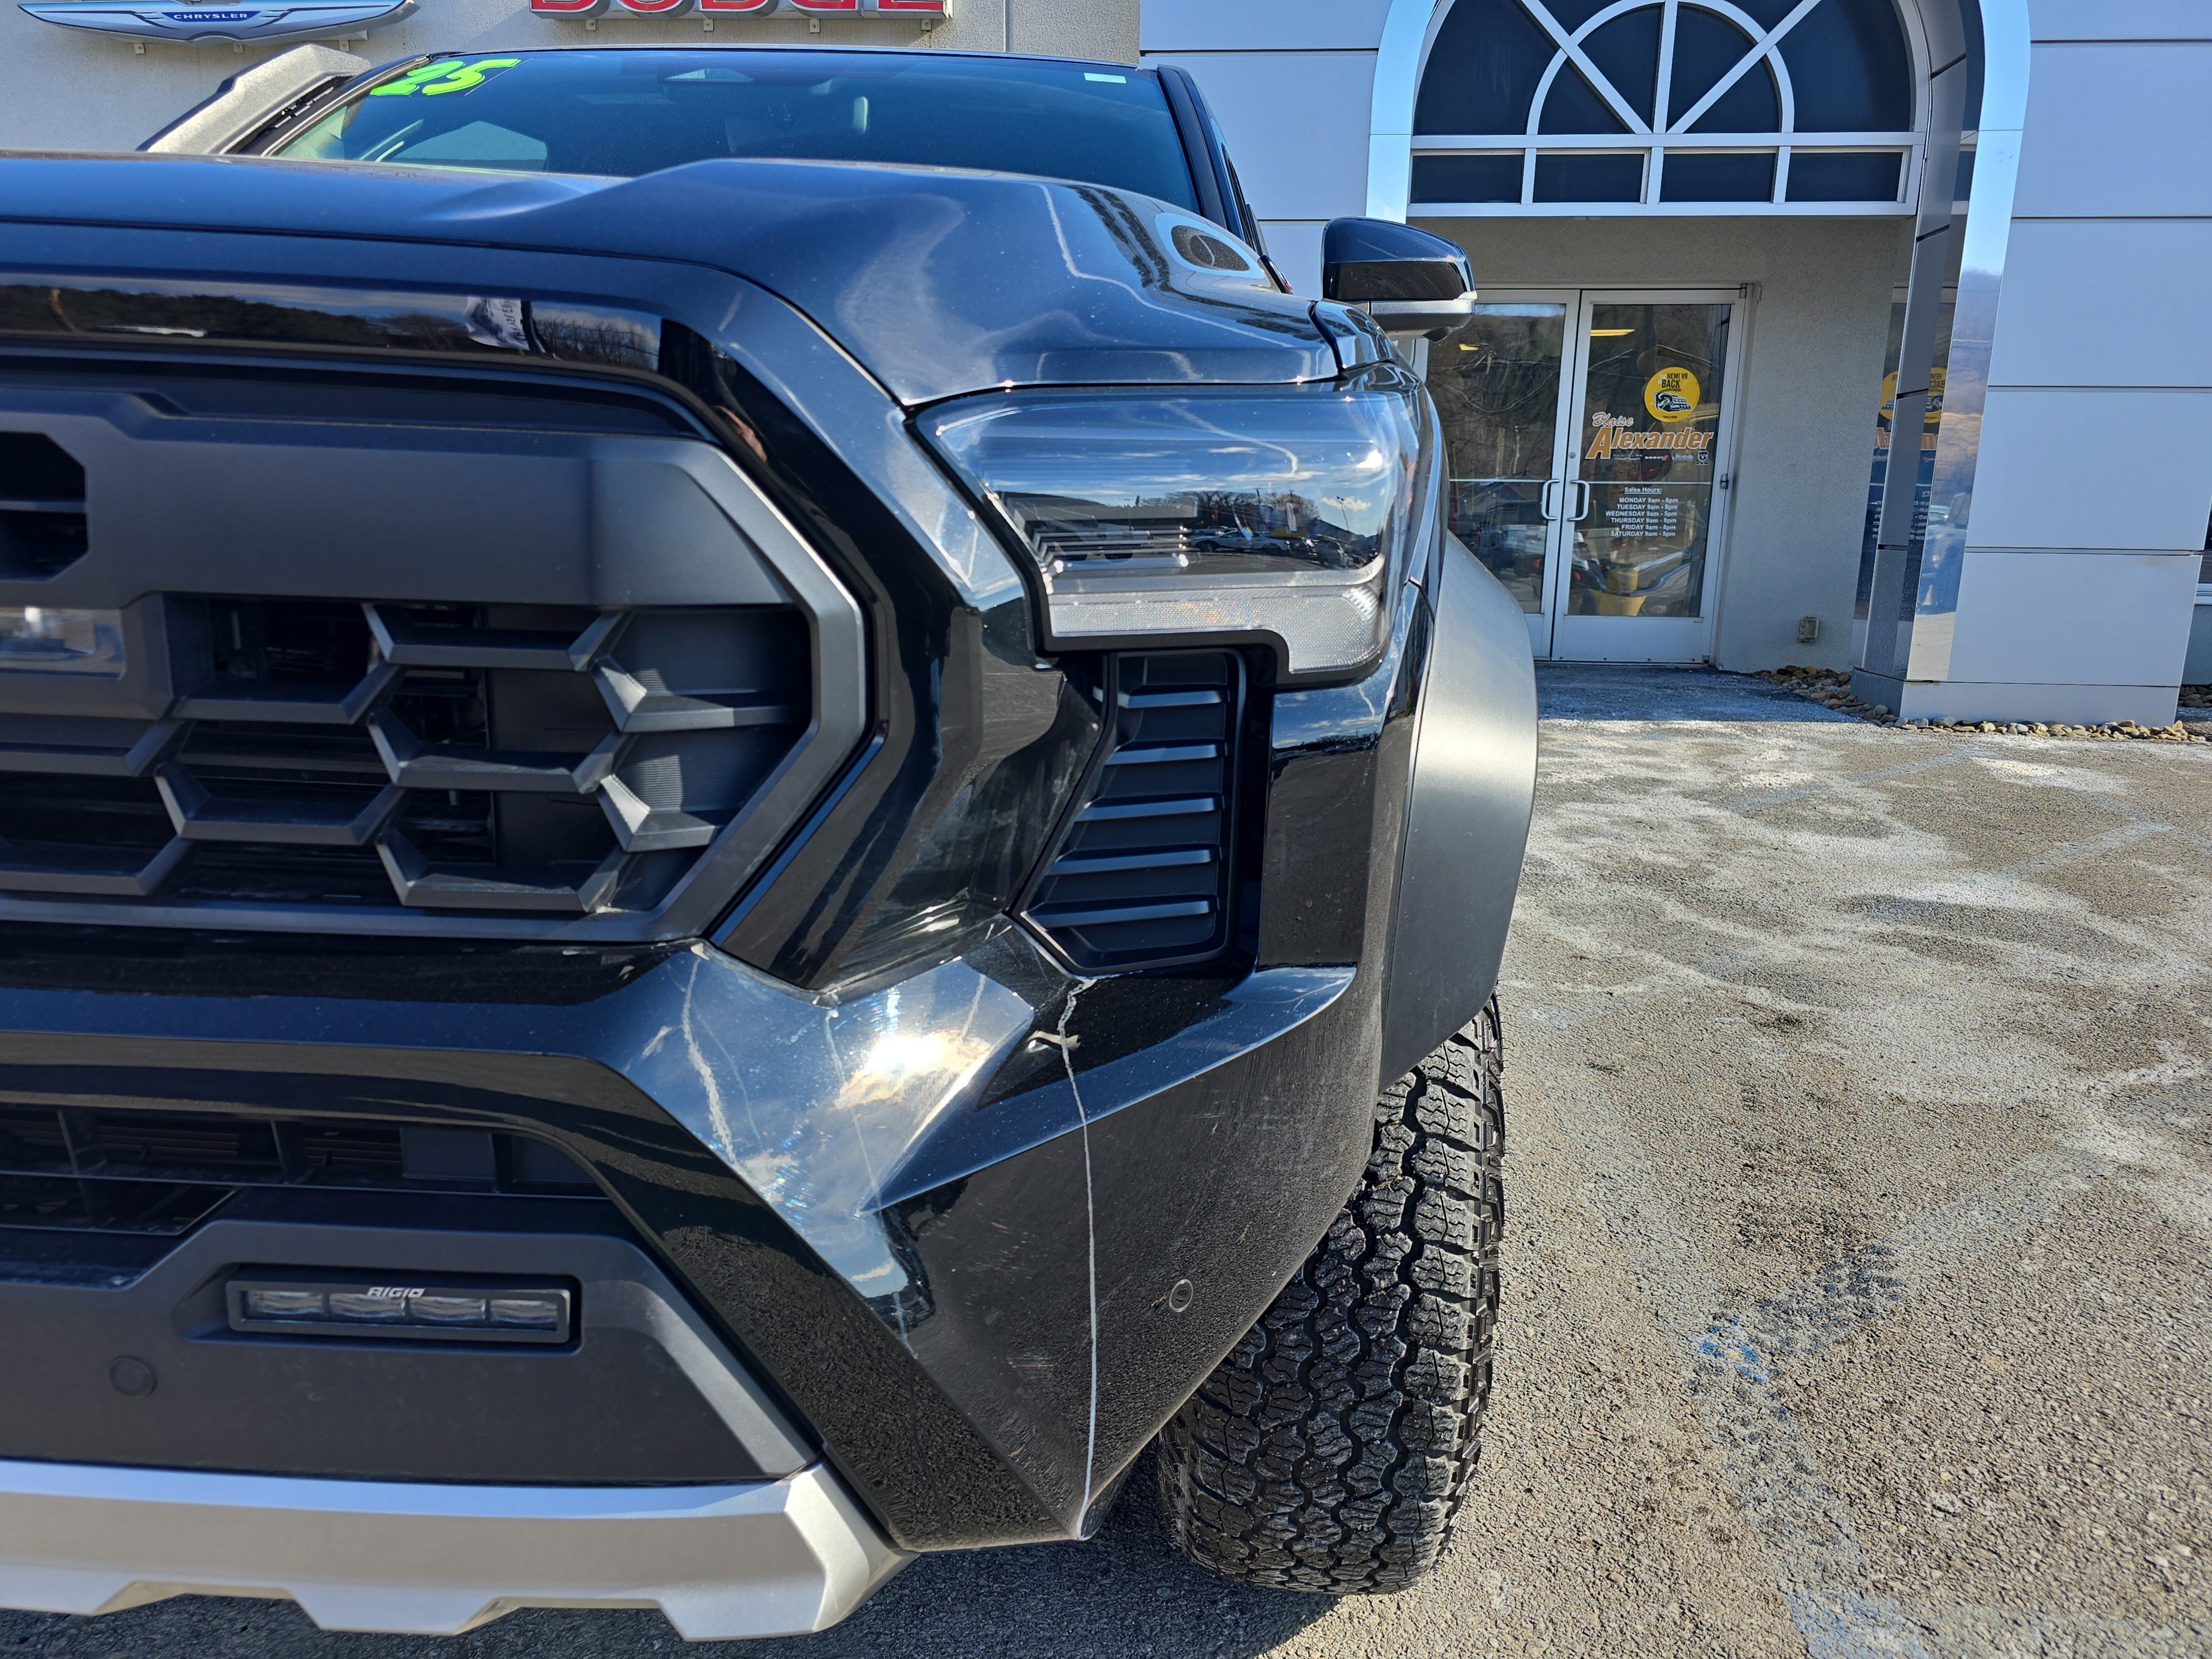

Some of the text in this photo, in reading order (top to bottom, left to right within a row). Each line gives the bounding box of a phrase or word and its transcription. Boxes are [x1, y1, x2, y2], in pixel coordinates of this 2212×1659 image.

[370, 59, 521, 95] 25
[1662, 379, 1680, 388] BACK
[1592, 412, 1634, 427] Blaise
[1585, 426, 1714, 459] Alexander
